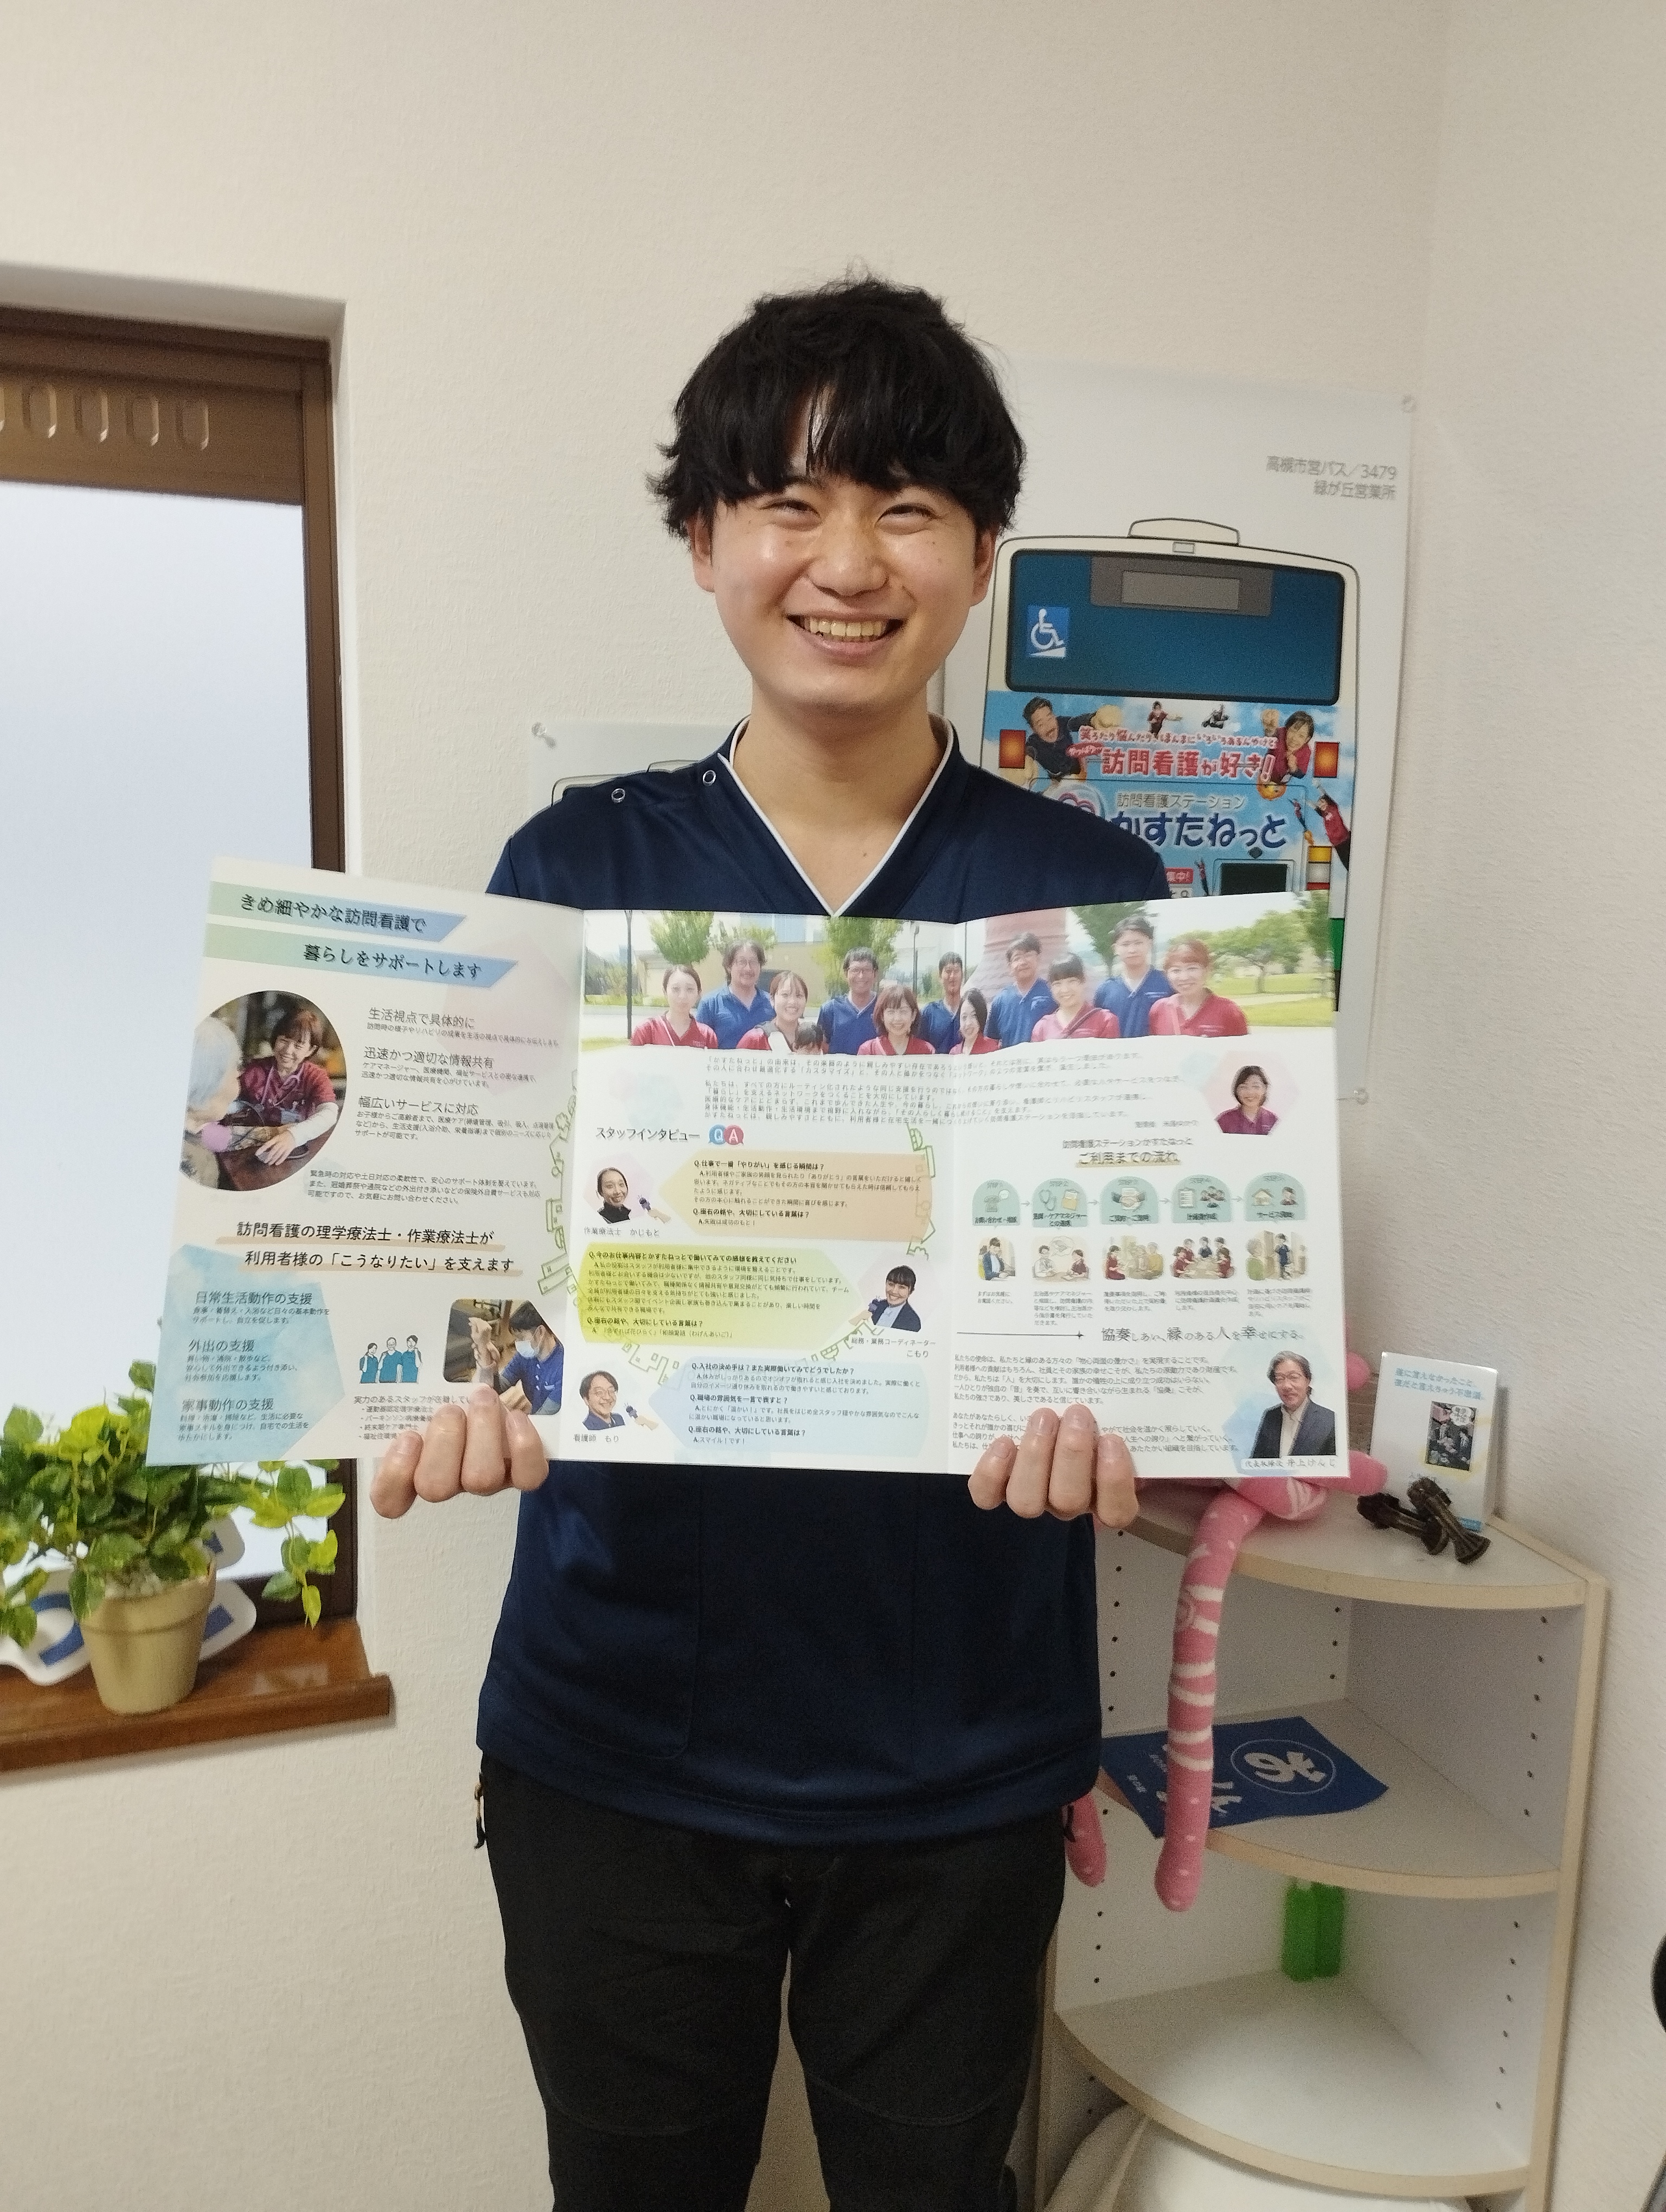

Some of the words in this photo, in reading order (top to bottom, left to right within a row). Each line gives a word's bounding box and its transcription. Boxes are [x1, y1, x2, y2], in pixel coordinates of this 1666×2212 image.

[1313, 479, 1398, 500] 緑が丘営業所
[1117, 793, 1246, 809] 訪問看護ステーション
[240, 893, 427, 933] きめ細やかな訪問看護で
[303, 943, 482, 979] 暮らしをサポートします
[368, 1007, 475, 1030] 生活視点で具体的に
[363, 1046, 494, 1069] 迅速かつ適切な情報共有
[358, 1096, 478, 1115] 幅広いサービスに対応
[355, 1130, 418, 1141] サポートが可能です。
[595, 1126, 700, 1142] スタッフインタビュー
[1079, 1150, 1178, 1165] ご利用までの流れ
[694, 1187, 742, 1195] たように感じます。
[236, 1221, 494, 1245] 訪問看護の理学療法士・作業療法士が
[584, 1226, 621, 1237] 作業療法士
[630, 1227, 660, 1238] かじもと
[245, 1251, 514, 1272] 利用者様の「こうなりたい」を支えます
[196, 1291, 312, 1305] 日常生活動作の支援
[189, 1339, 255, 1353] 外出の支援
[907, 1351, 929, 1359] こもり
[181, 1398, 274, 1412] 家事動作の支援
[573, 1433, 597, 1443] 看護師
[604, 1435, 619, 1443] もり
